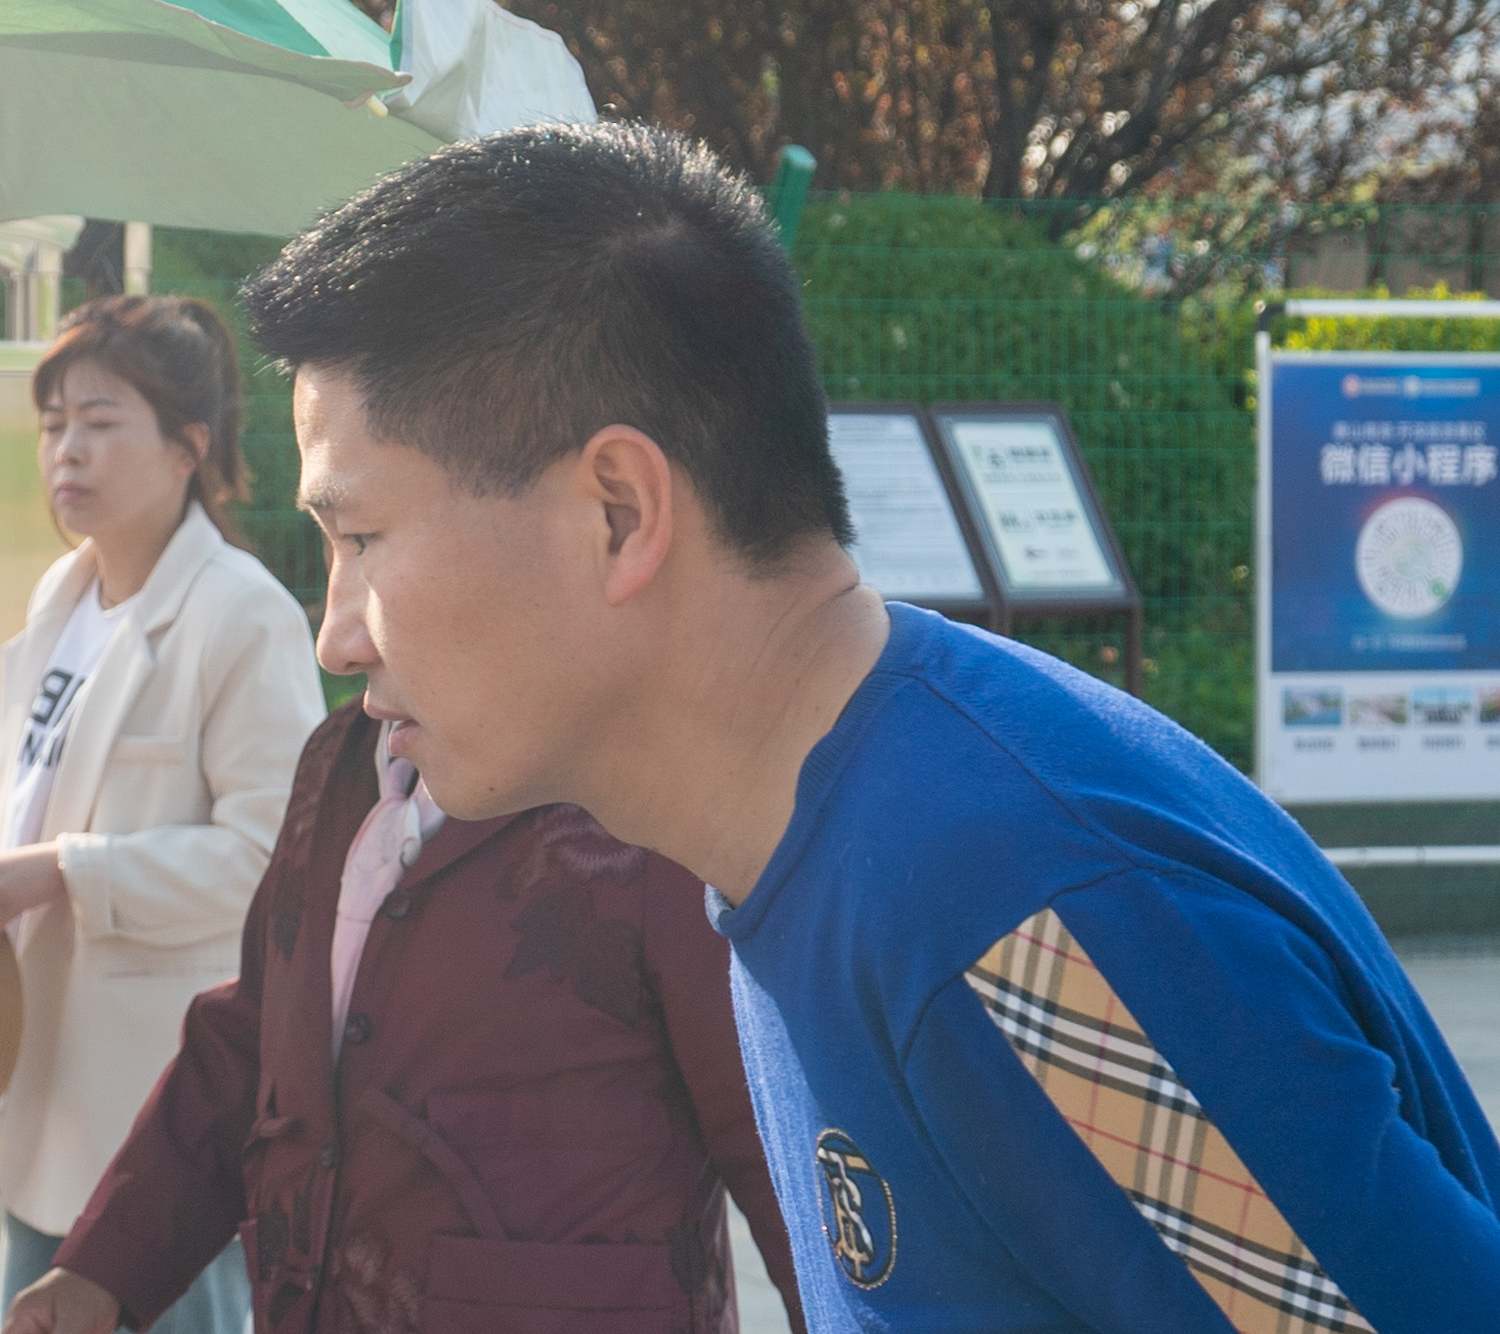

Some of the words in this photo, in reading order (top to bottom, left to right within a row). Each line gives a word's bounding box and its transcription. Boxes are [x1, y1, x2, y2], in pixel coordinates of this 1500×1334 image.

[1320, 443, 1498, 485] 微信小程序
